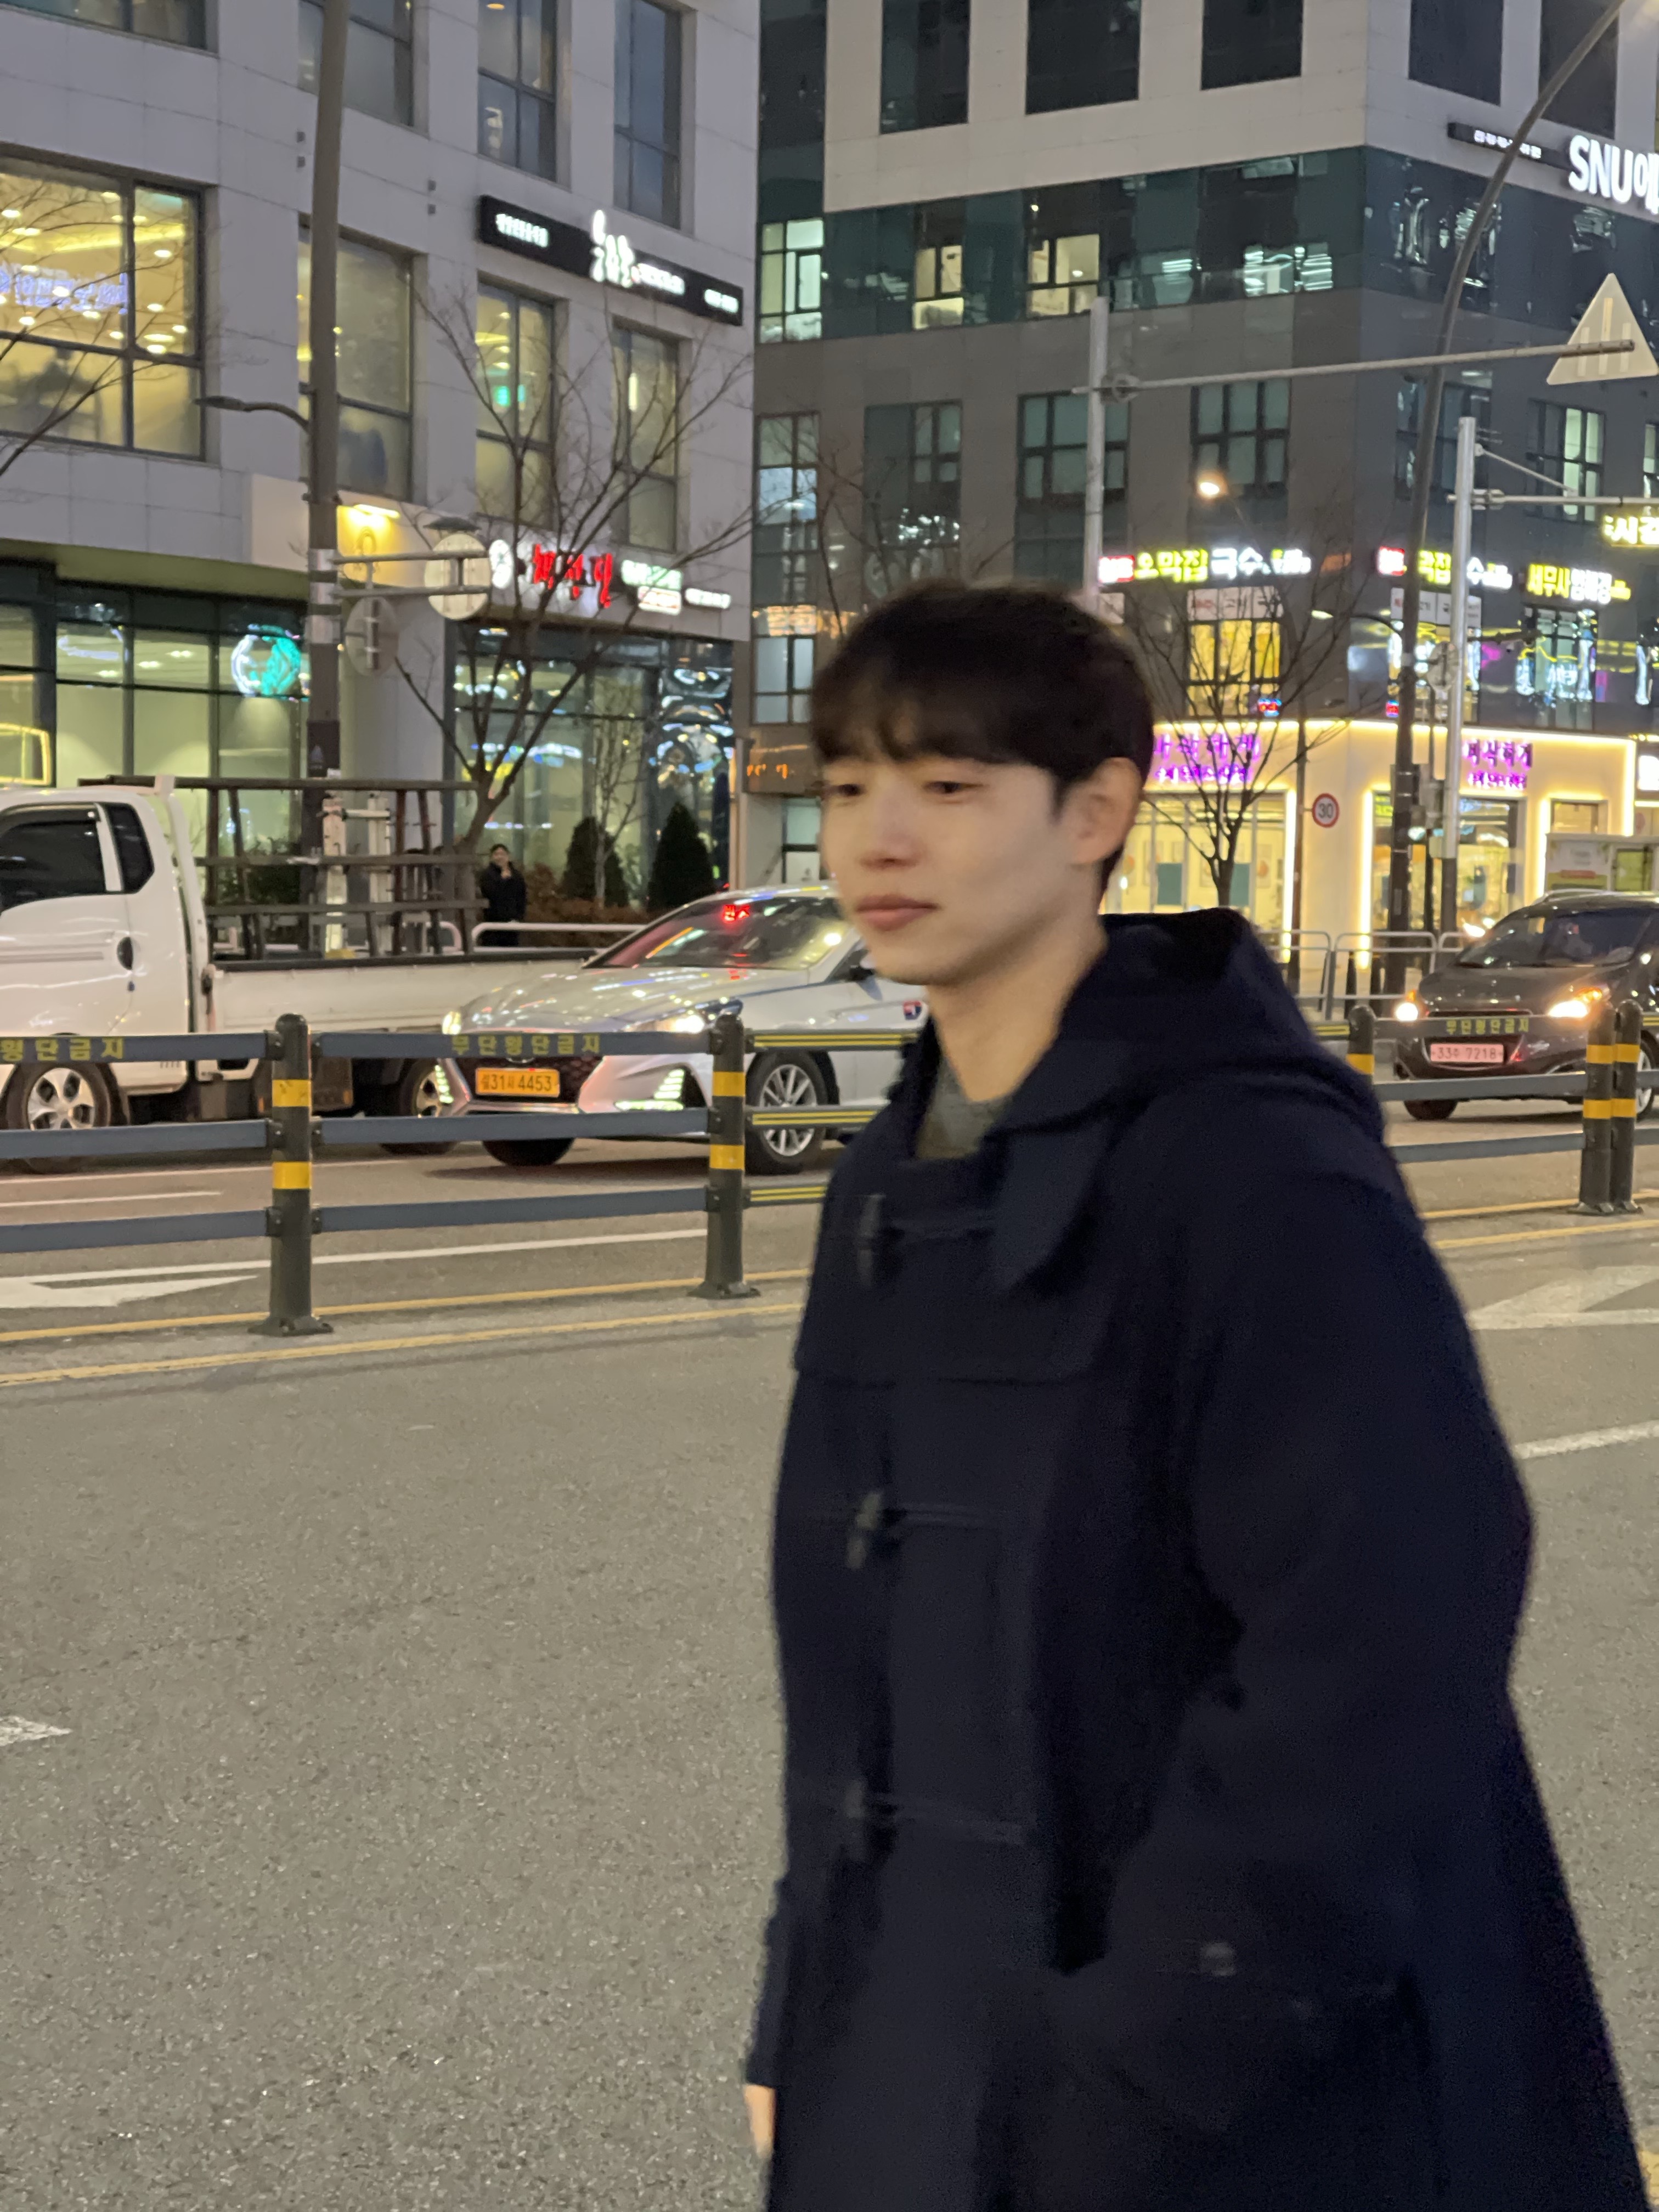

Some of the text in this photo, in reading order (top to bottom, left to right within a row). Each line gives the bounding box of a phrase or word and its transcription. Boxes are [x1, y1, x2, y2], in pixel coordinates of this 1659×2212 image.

[1528, 563, 1570, 599] 세무사
[1318, 803, 1334, 819] 30
[1446, 1018, 1528, 1035] 무단횡단금지
[452, 1035, 600, 1056] 무단횡단금지
[1465, 1047, 1496, 1060] 7218
[518, 1074, 552, 1091] 4453
